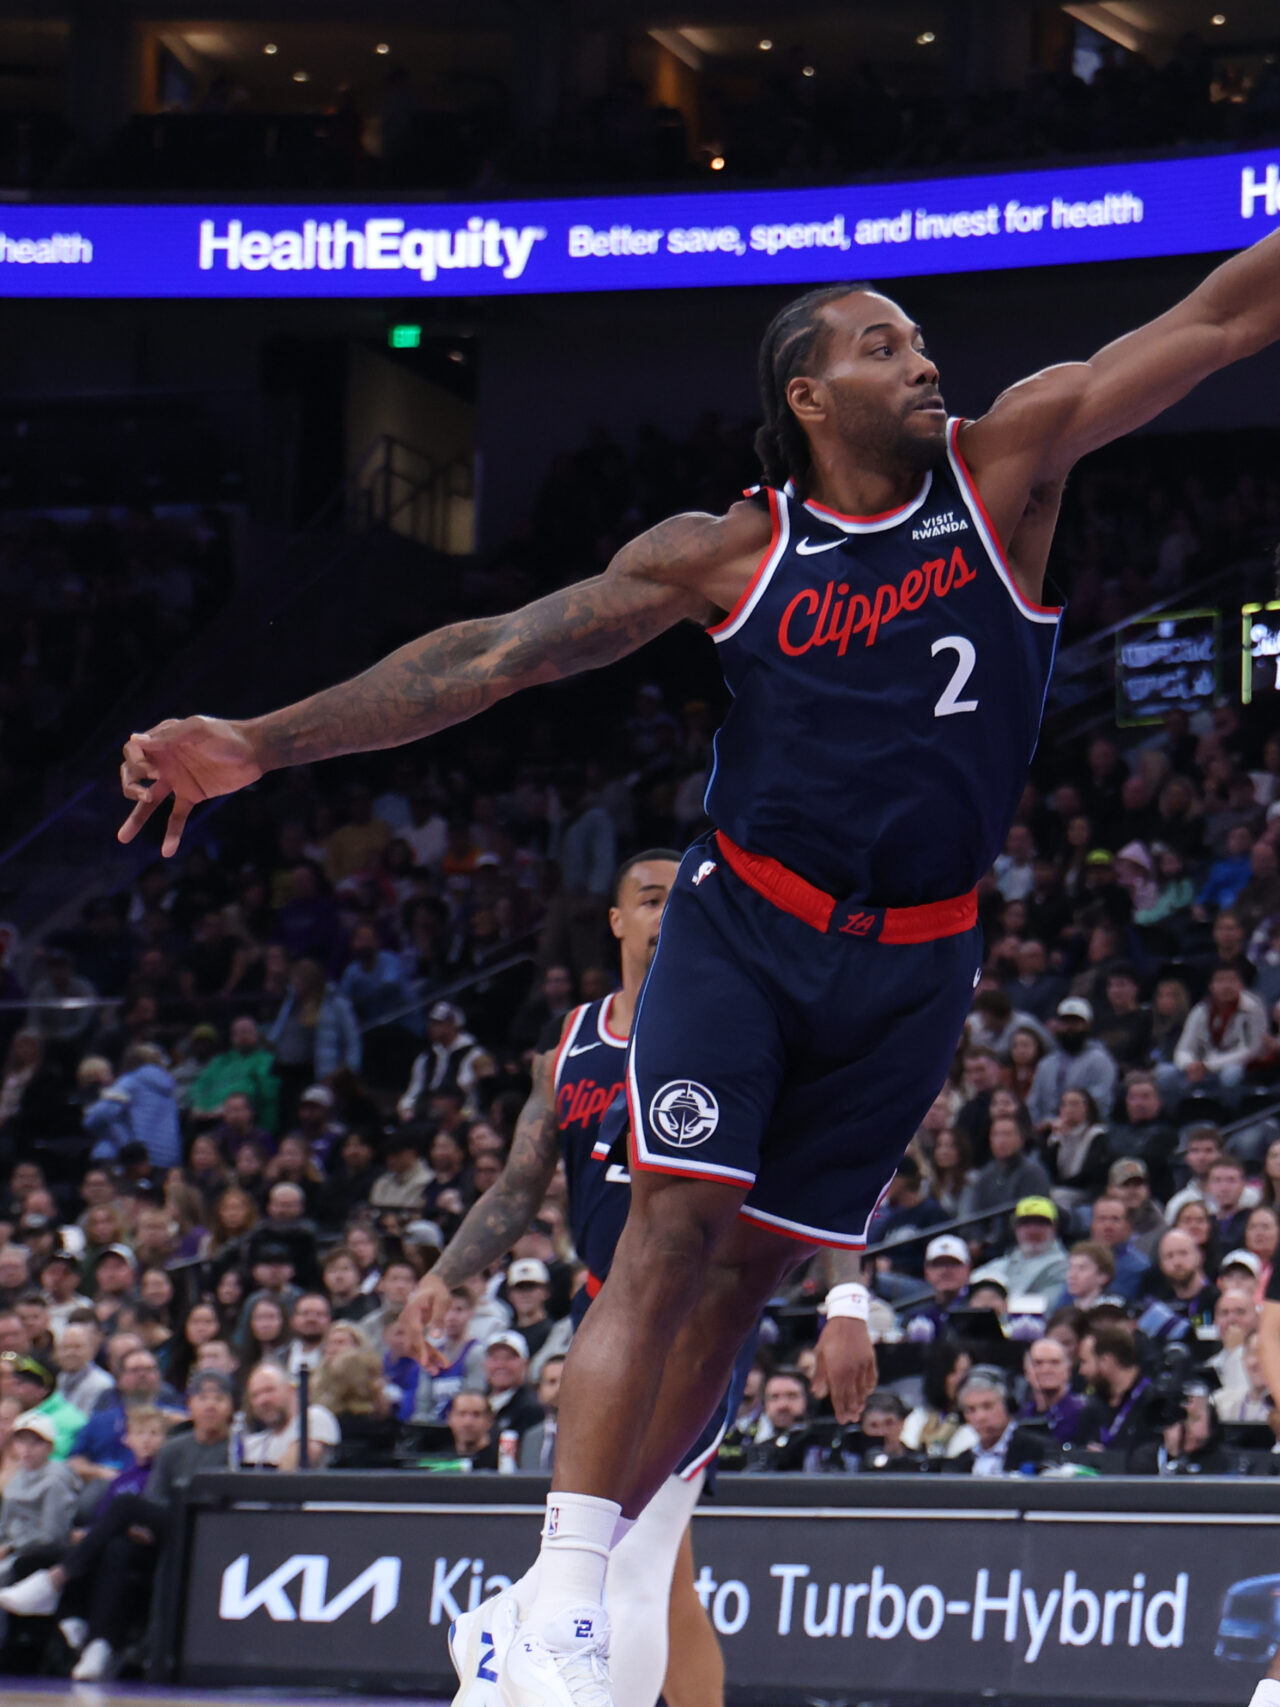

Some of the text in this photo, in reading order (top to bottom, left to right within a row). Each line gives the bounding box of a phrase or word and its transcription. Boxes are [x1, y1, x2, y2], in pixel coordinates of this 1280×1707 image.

[0, 233, 92, 264] health
[200, 217, 540, 281] HealthEquity
[568, 190, 1144, 257] Better save, spend, and invest for health
[912, 519, 969, 541] RWANDA
[922, 511, 954, 529] VISIT
[778, 546, 977, 656] Clippers
[931, 635, 979, 717] 2
[770, 1563, 1189, 1664] Turbo-Hybrid
